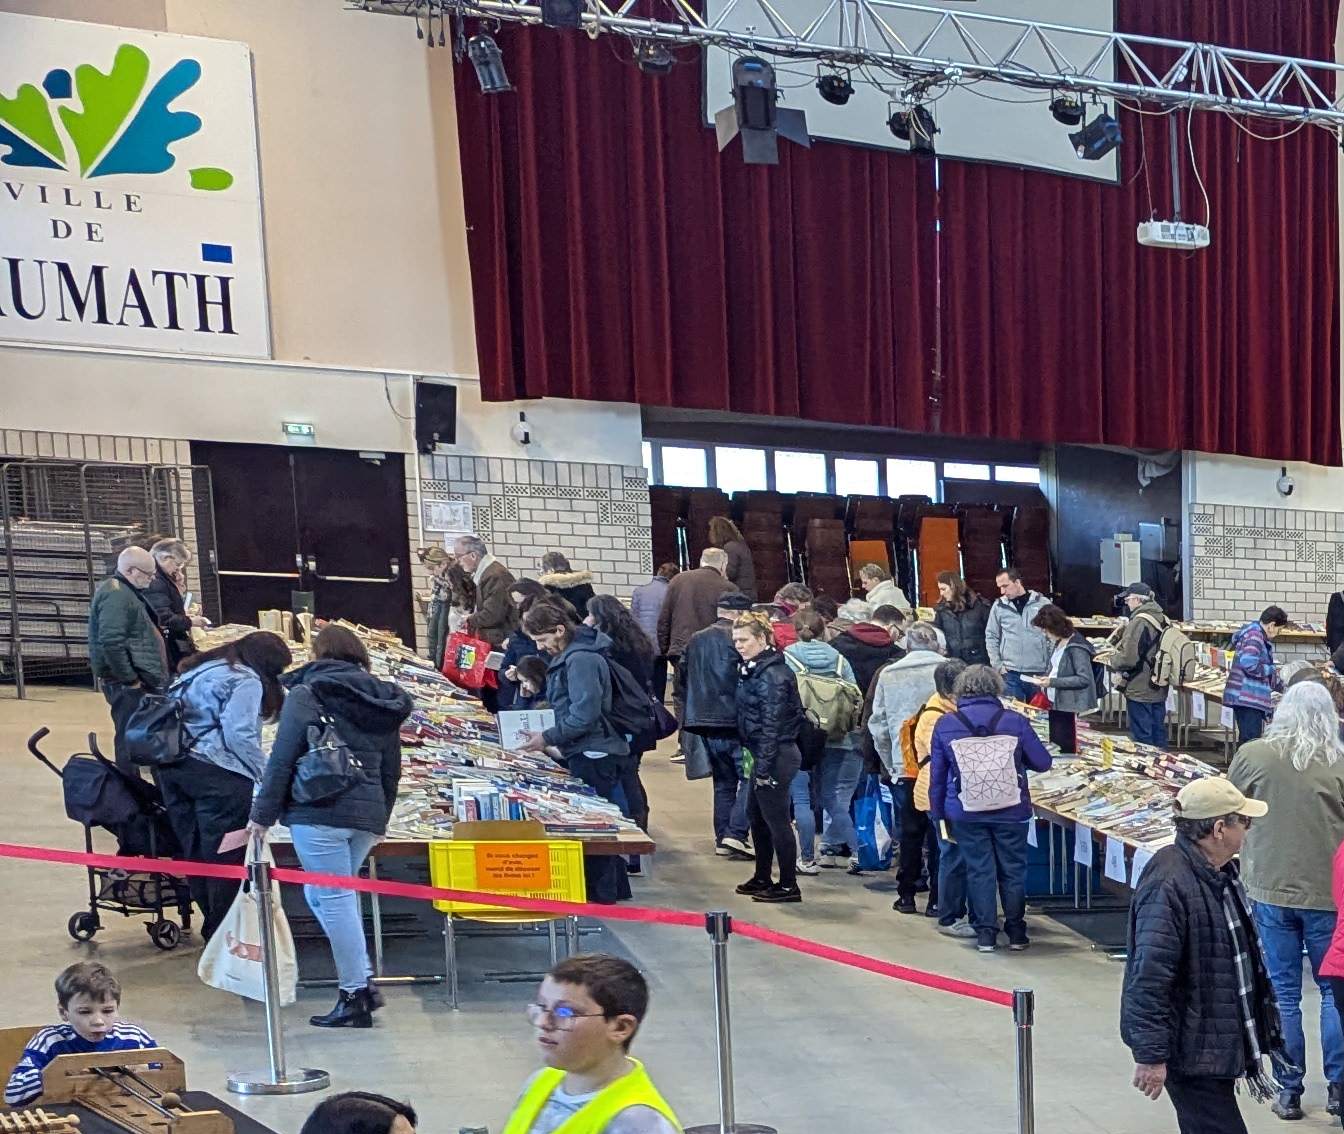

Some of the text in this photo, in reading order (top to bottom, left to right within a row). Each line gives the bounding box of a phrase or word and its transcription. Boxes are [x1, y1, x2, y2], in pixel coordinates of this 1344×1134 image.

[4, 181, 143, 213] VILLE
[50, 218, 104, 243] DE
[0, 256, 240, 335] UMATH
